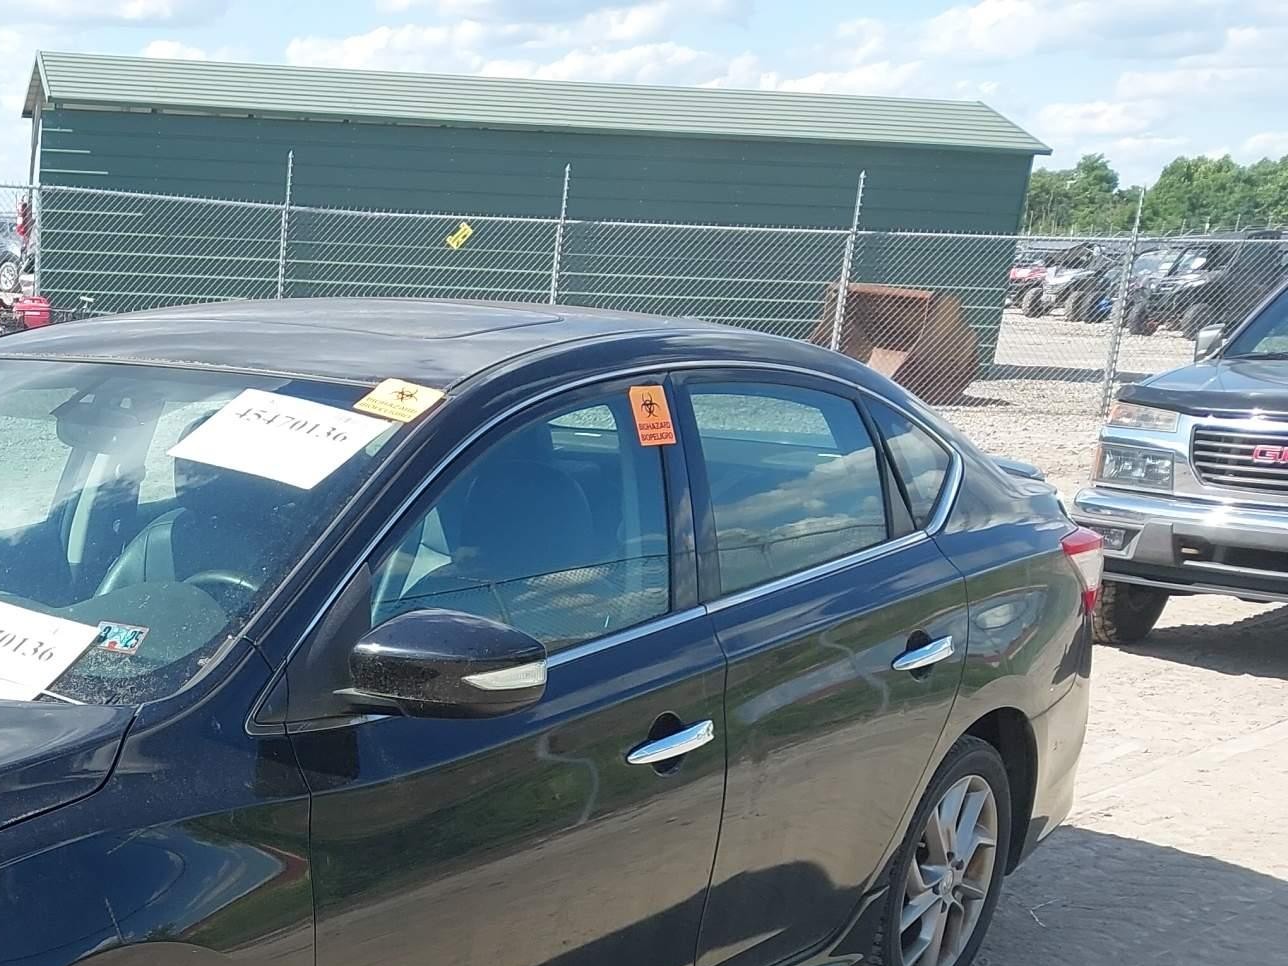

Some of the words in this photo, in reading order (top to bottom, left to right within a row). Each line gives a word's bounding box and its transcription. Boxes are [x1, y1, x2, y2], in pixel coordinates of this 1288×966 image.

[235, 407, 348, 443] 45470136
[638, 421, 671, 431] BIOHAZARD
[641, 432, 674, 442] BIOPELIGRO
[123, 630, 144, 649] 25
